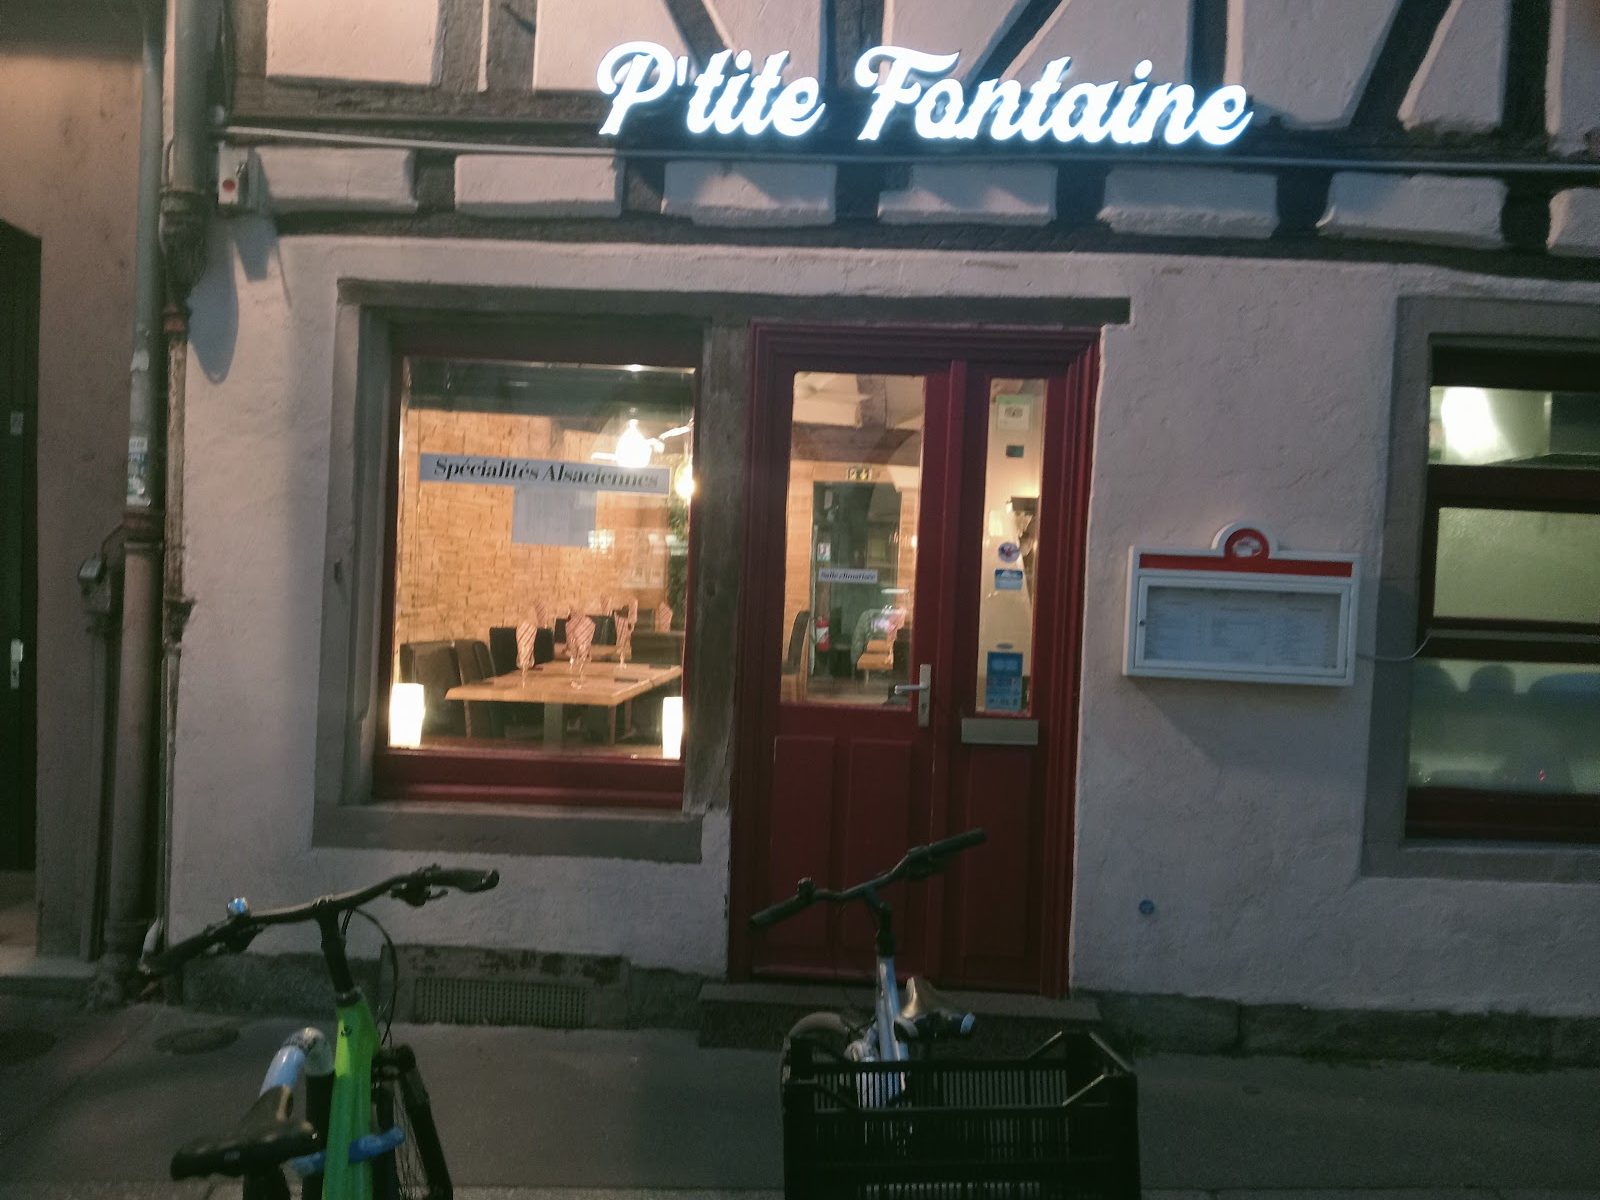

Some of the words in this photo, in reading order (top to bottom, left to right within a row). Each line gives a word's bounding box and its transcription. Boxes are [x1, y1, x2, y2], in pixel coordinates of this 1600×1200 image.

[597, 41, 826, 136] P'tite
[854, 45, 1254, 146] Fontaine
[434, 457, 539, 480] Spécialités
[541, 464, 659, 489] Alsaciennes
